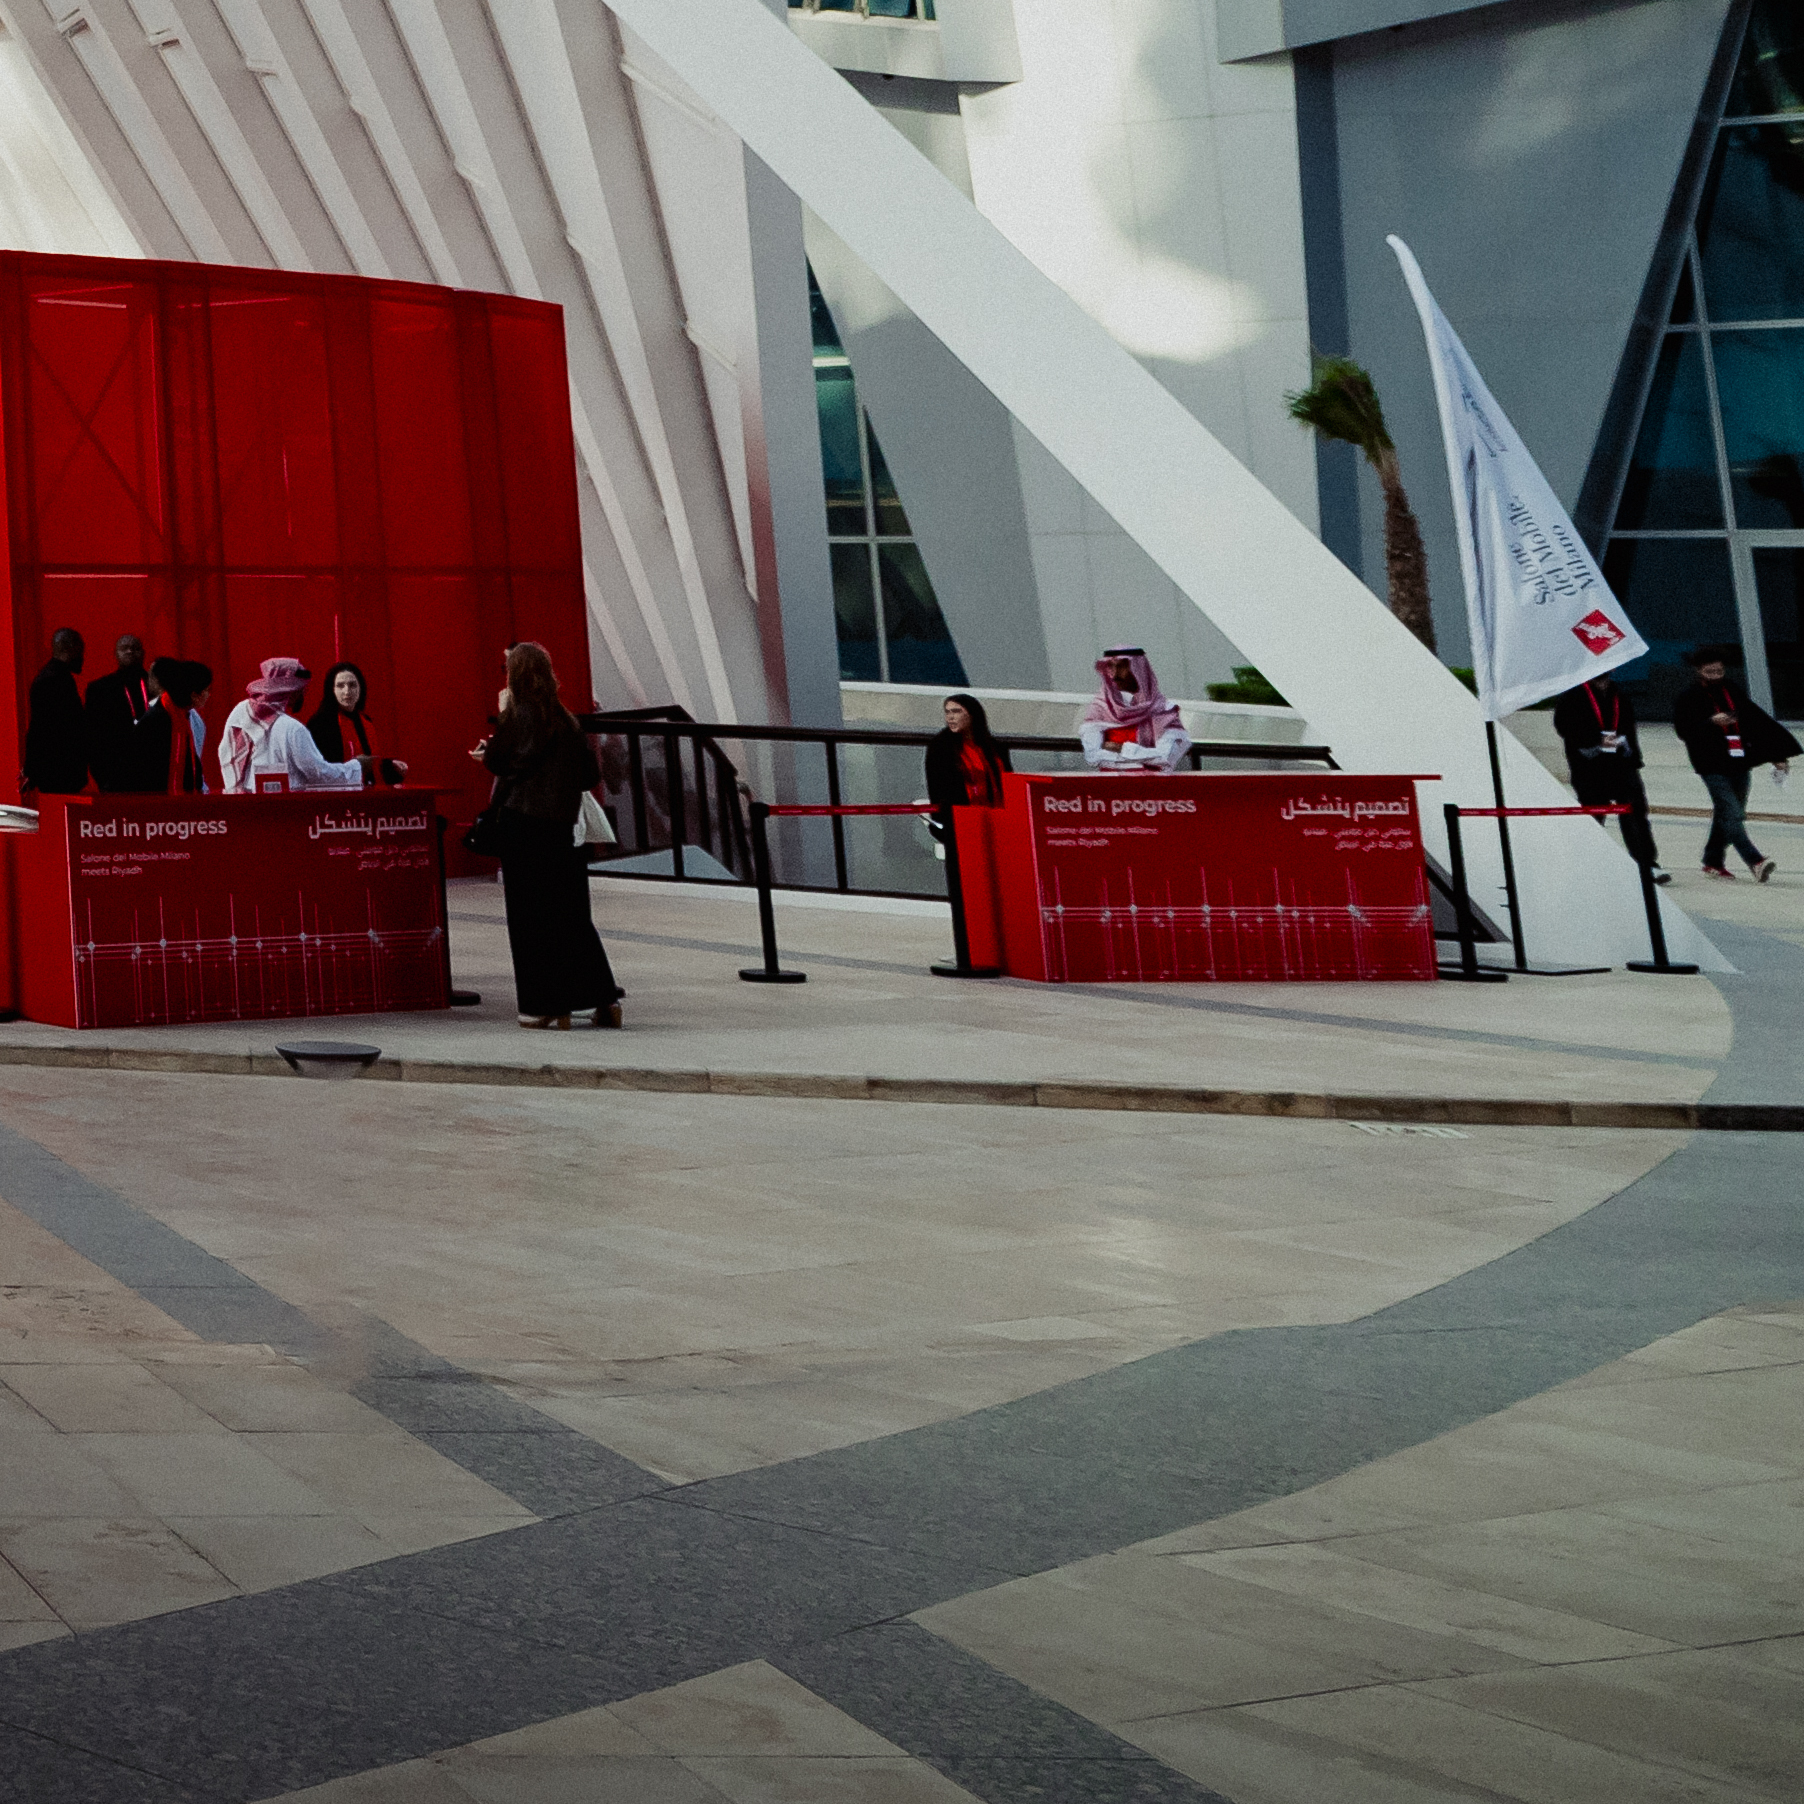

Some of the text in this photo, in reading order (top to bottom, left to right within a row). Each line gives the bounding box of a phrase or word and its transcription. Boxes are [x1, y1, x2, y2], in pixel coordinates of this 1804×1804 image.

[1511, 542, 1553, 606] Salone
[1044, 795, 1197, 817] Red in progress
[80, 817, 228, 841] Red in progress
[308, 809, 428, 840] تصميم يتشكل
